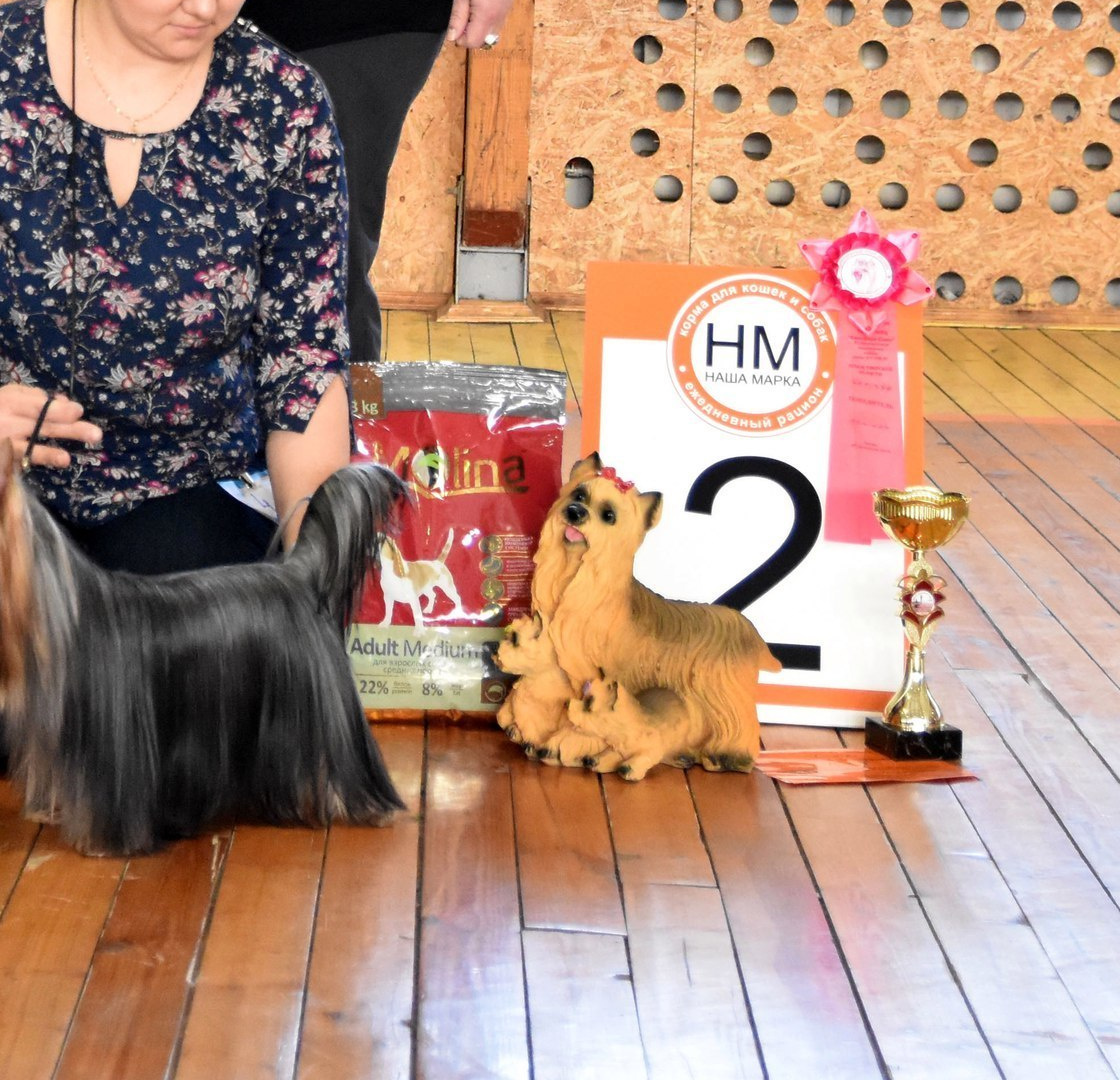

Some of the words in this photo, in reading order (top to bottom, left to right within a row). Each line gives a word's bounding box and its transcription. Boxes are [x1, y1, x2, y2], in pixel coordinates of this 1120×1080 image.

[679, 299, 709, 337] корма
[710, 285, 737, 303] для
[741, 283, 788, 300] кошек
[788, 295, 800, 307] и
[800, 305, 829, 344] собак
[706, 322, 800, 372] НМ
[705, 371, 748, 385] НАША
[751, 373, 801, 387] МАРКА
[361, 399, 379, 415] kg
[684, 382, 773, 429] ежедневный
[776, 387, 824, 427] рацион
[684, 455, 823, 672] 2
[350, 637, 400, 657] Adult
[359, 680, 389, 695] 22%
[422, 683, 443, 697] 8%
